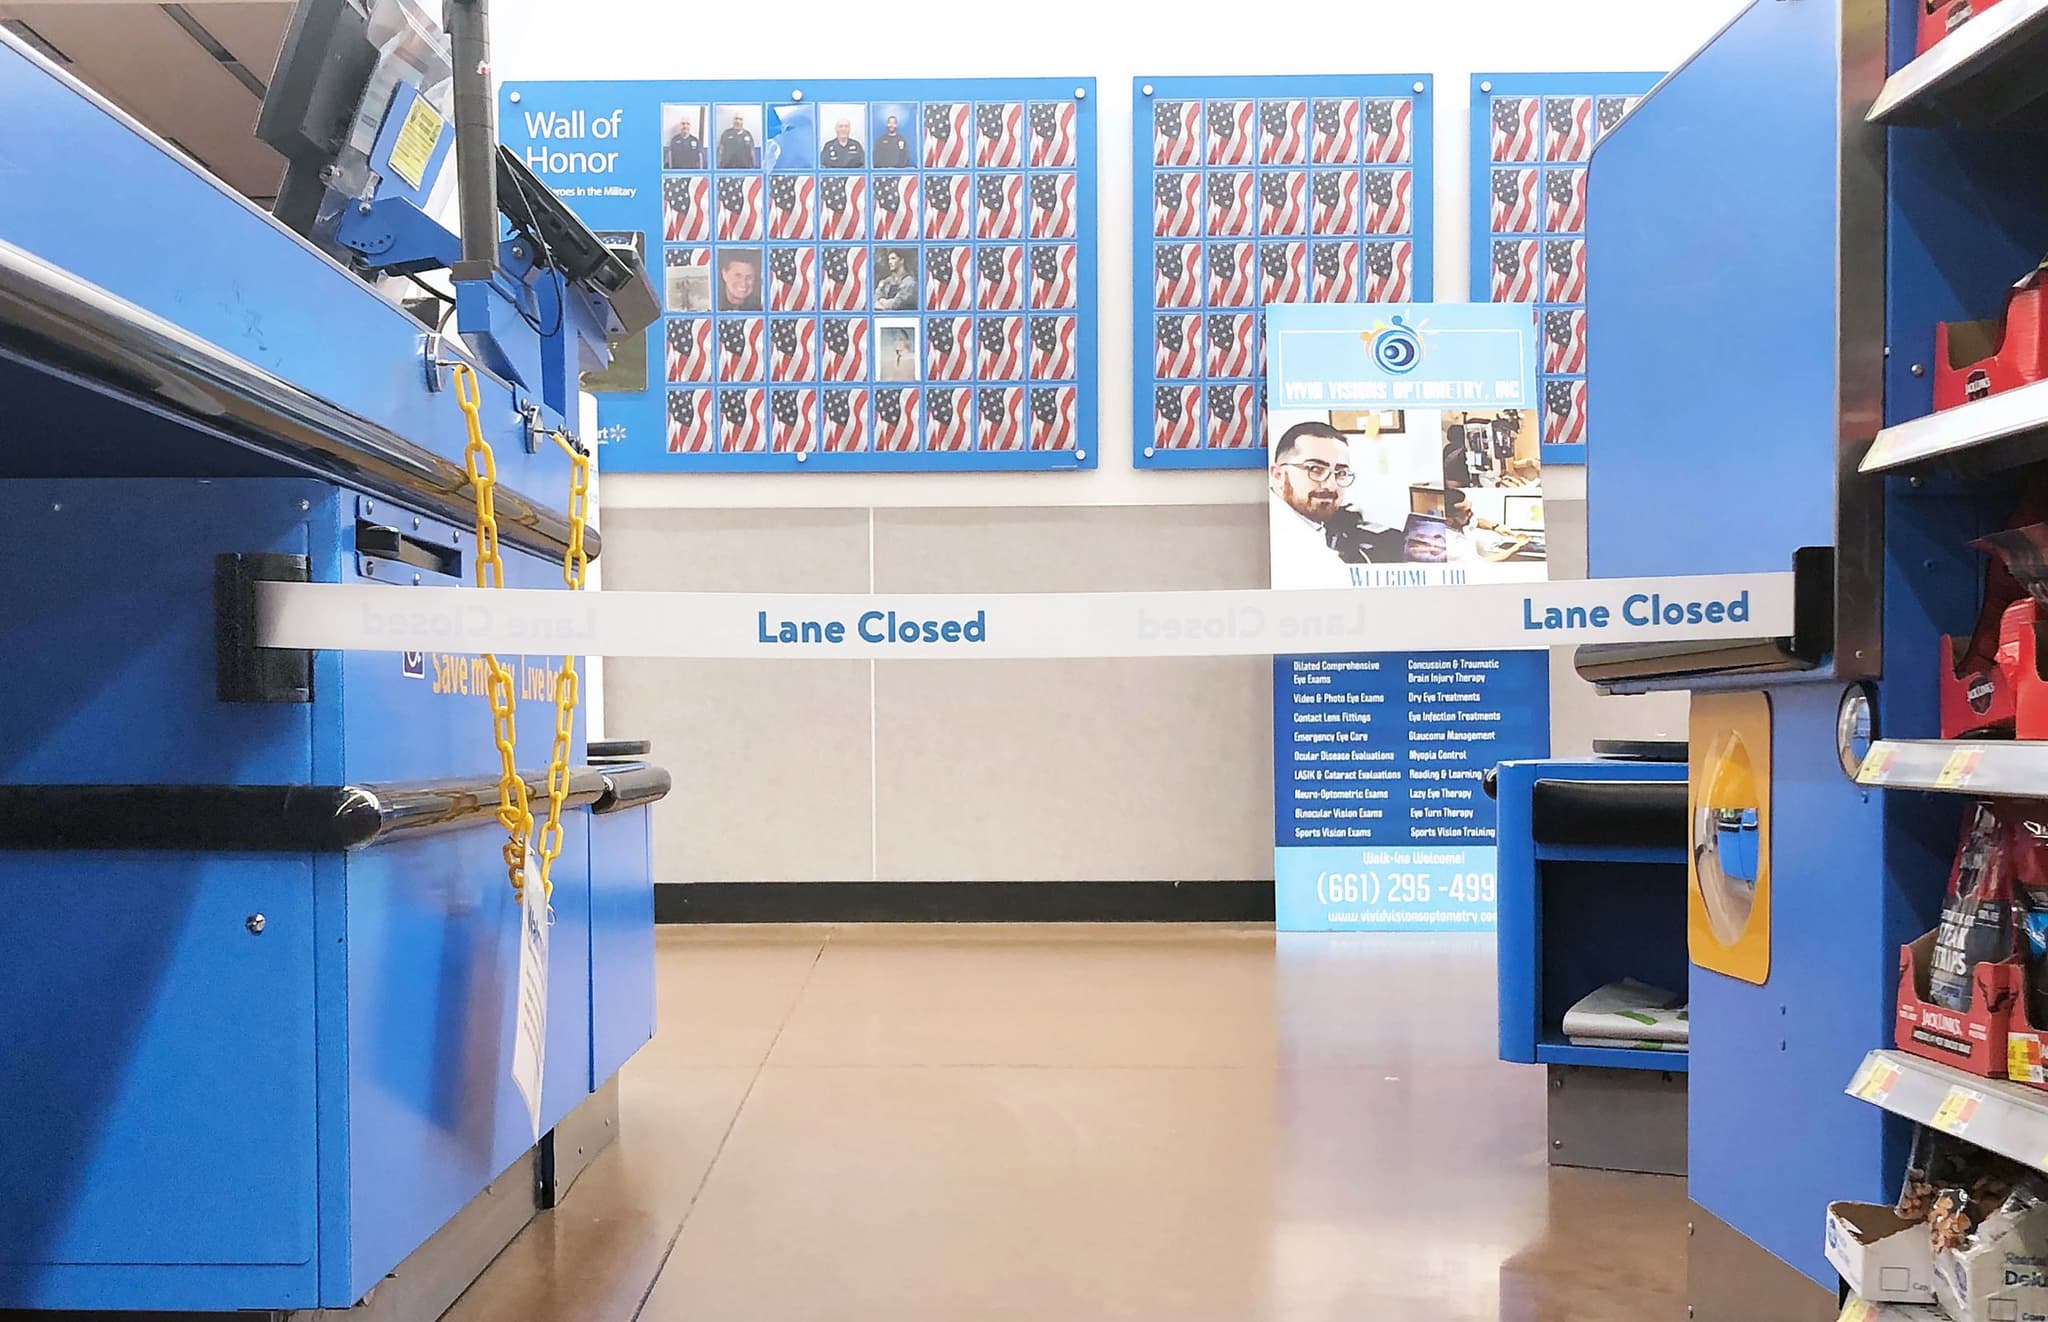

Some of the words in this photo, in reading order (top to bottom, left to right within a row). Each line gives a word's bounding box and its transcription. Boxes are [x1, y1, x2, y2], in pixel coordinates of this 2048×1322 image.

[524, 110, 585, 139] Wall
[592, 109, 623, 139] of
[527, 146, 619, 174] Honor
[551, 188, 575, 196] eroes
[576, 186, 586, 196] in
[587, 186, 602, 196] the
[604, 186, 636, 198] Military
[1523, 598, 1610, 630] Lane
[1622, 590, 1750, 627] Closed
[757, 610, 846, 644] Lane
[856, 610, 987, 644] Closed
[1294, 661, 1320, 671] Dilated
[1322, 661, 1380, 672] Comprehensive
[1408, 659, 1451, 669] Concussion
[1460, 658, 1499, 669] Traumatic
[432, 652, 468, 696] Save
[1294, 674, 1306, 685] Eye
[1307, 674, 1331, 684] Exams
[1408, 673, 1429, 683] Brain
[1431, 672, 1454, 684] Injury
[1455, 672, 1486, 684] Therapy
[1293, 693, 1315, 703] Video
[1324, 693, 1345, 703] Photo
[1346, 693, 1359, 704] Eye
[1361, 693, 1384, 702] Exams
[1408, 692, 1422, 703] Dry
[1423, 692, 1436, 703] Eye
[1437, 692, 1480, 702] Treatments
[1293, 713, 1322, 723] Contact
[1324, 713, 1340, 722] Lens
[1342, 712, 1371, 724] Fittings
[1408, 711, 1421, 723] Eye
[1423, 711, 1456, 722] Infection
[1458, 711, 1501, 721] Treatments
[1294, 732, 1334, 743] Emergency
[1336, 732, 1348, 743] Eye
[1350, 732, 1368, 741] Care
[1409, 730, 1445, 740] Glaucoma
[1447, 730, 1495, 742] Management
[1294, 751, 1319, 760] Ocular
[1321, 751, 1350, 760] Disease
[1351, 750, 1394, 760] Evaluations
[1409, 750, 1437, 761] Myopia
[1438, 750, 1467, 760] Control
[1295, 770, 1315, 780] LASIK
[1324, 770, 1356, 780] Cataract
[1358, 769, 1401, 780] Evaluations
[1409, 769, 1440, 780] Reading
[1448, 769, 1482, 780] Learning
[1295, 789, 1363, 800] Neuro-Optometric
[1365, 789, 1388, 799] Exams
[1410, 788, 1426, 800] Lazy
[1428, 788, 1440, 800] Eye
[1441, 788, 1472, 800] Therapy
[1295, 808, 1332, 818] Binocular
[1333, 808, 1358, 818] Vision
[1359, 808, 1383, 818] Exams
[1410, 808, 1423, 819] Eye
[1424, 808, 1442, 817] Turn
[1443, 807, 1474, 818] Therapy
[1295, 828, 1320, 839] Sports
[1322, 827, 1346, 837] Vision
[1348, 827, 1371, 837] Exams
[1410, 827, 1436, 838] Sports
[1437, 827, 1462, 836] Vision
[1463, 826, 1496, 838] Training
[1413, 851, 1465, 864] Welcome!
[1316, 871, 1380, 904] (661)
[1387, 873, 1431, 903] 295
[1438, 873, 1496, 903] -499
[1937, 922, 1969, 950] TEAK
